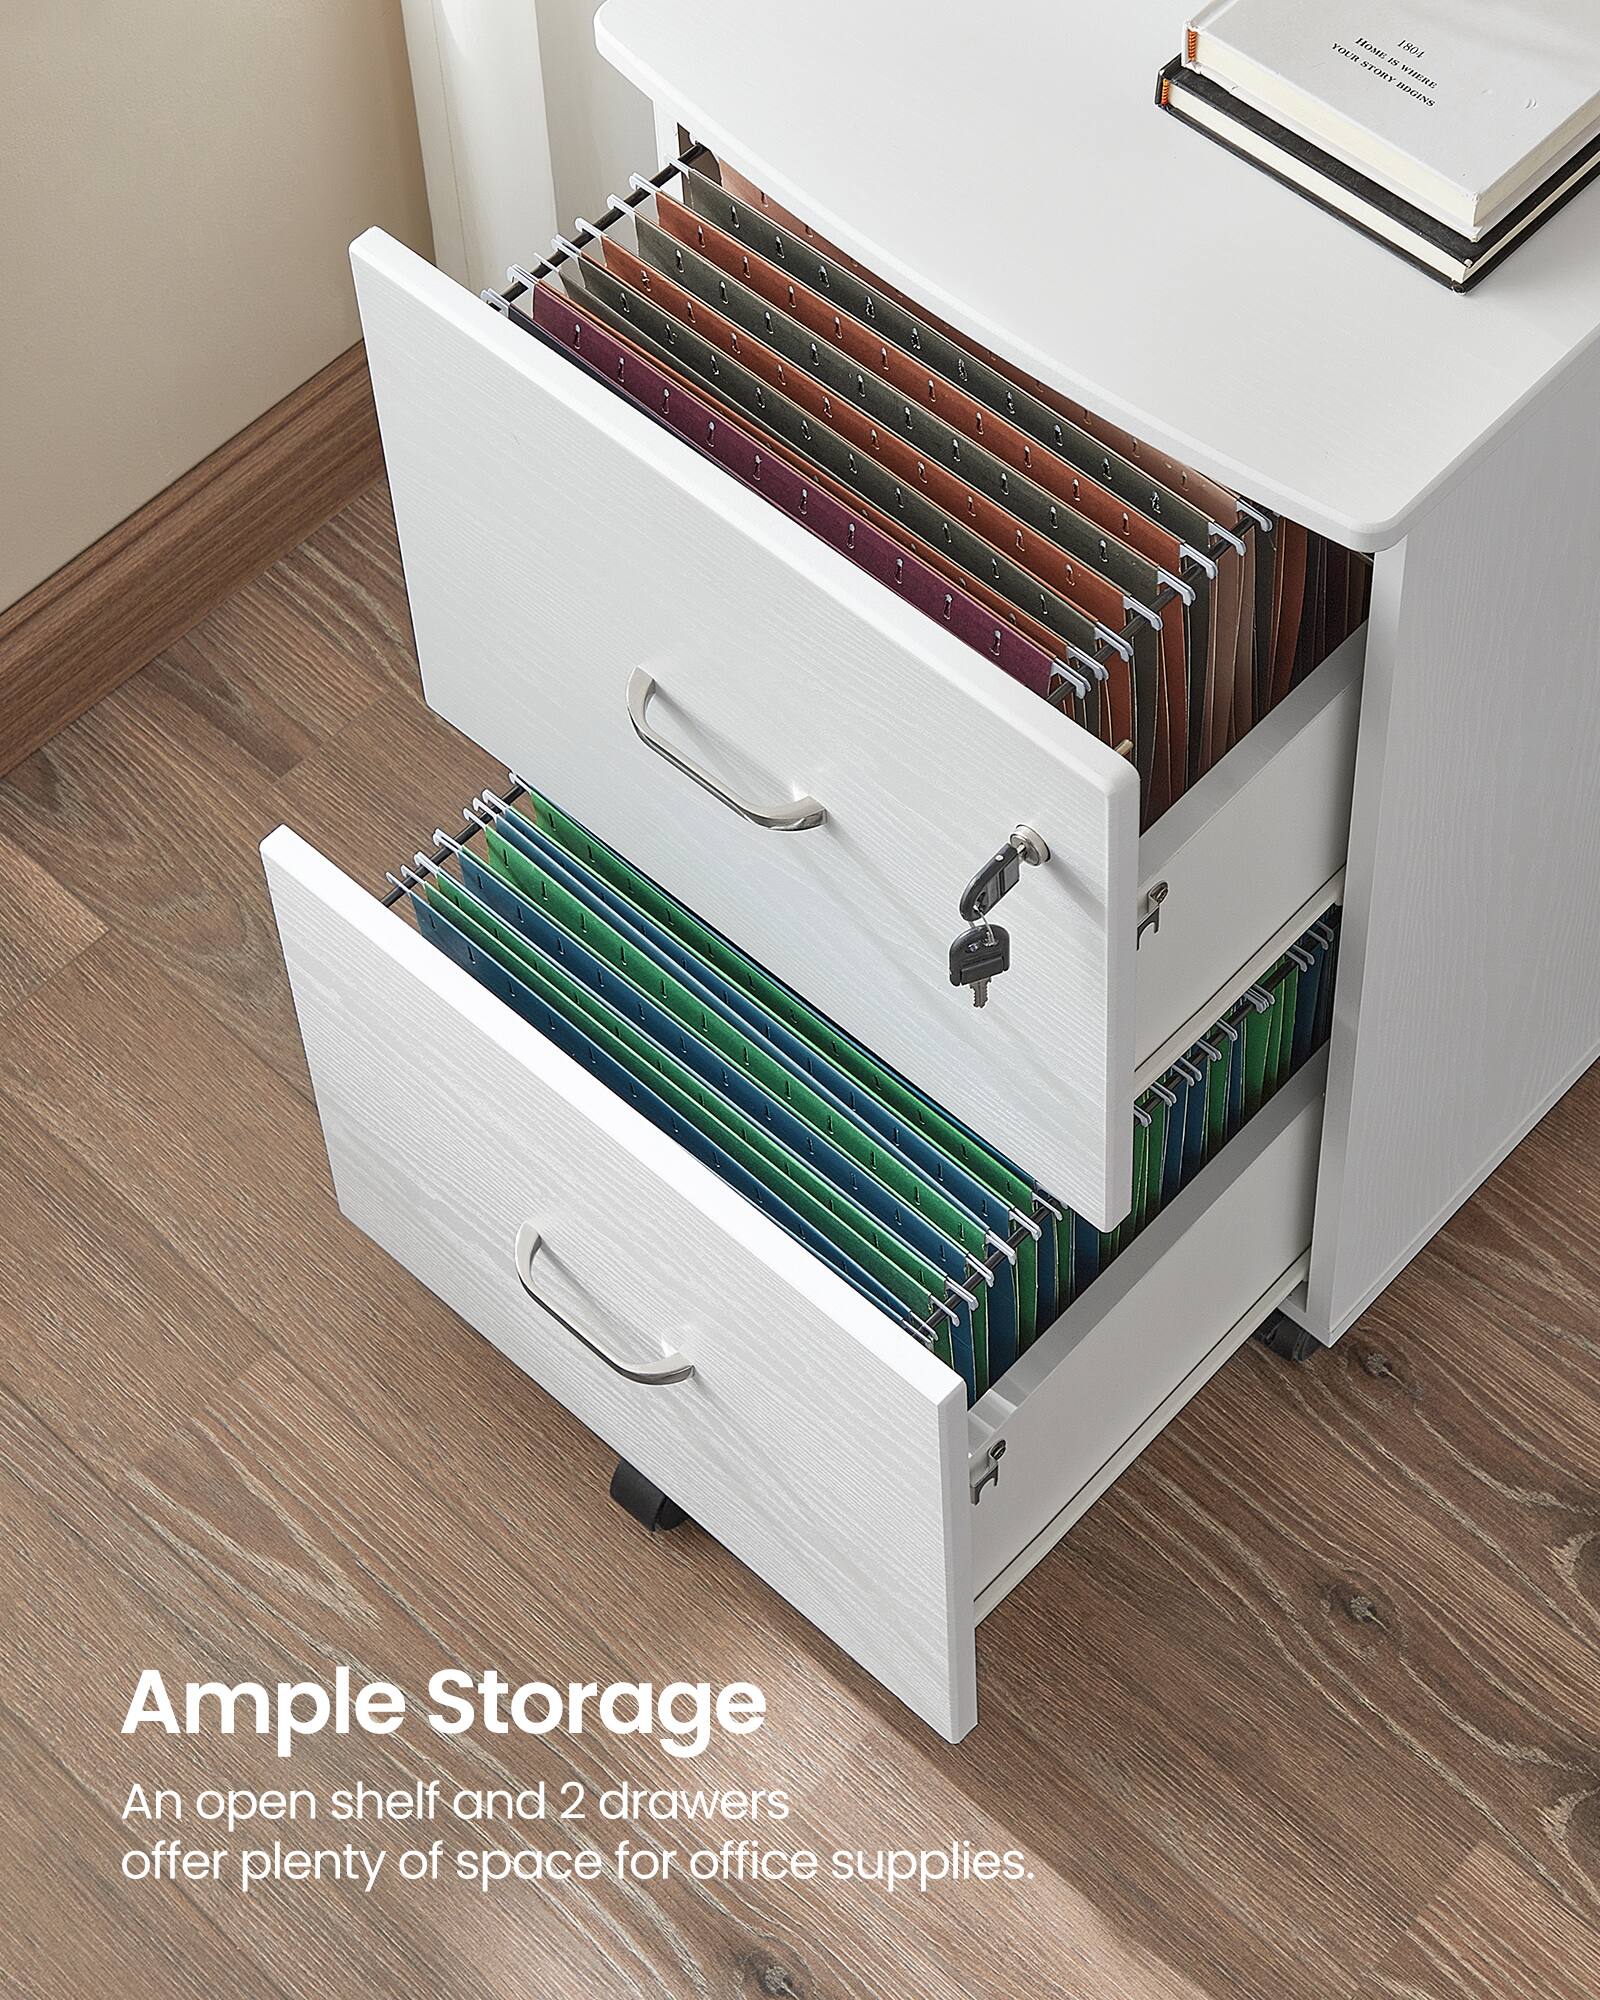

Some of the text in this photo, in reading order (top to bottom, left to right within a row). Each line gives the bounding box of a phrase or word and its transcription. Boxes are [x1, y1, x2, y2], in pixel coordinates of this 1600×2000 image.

[1331, 42, 1360, 63] YOUR
[1360, 59, 1396, 83] STORY
[1354, 37, 1438, 89] HOME IS WHERE
[1397, 39, 1425, 59] 1804
